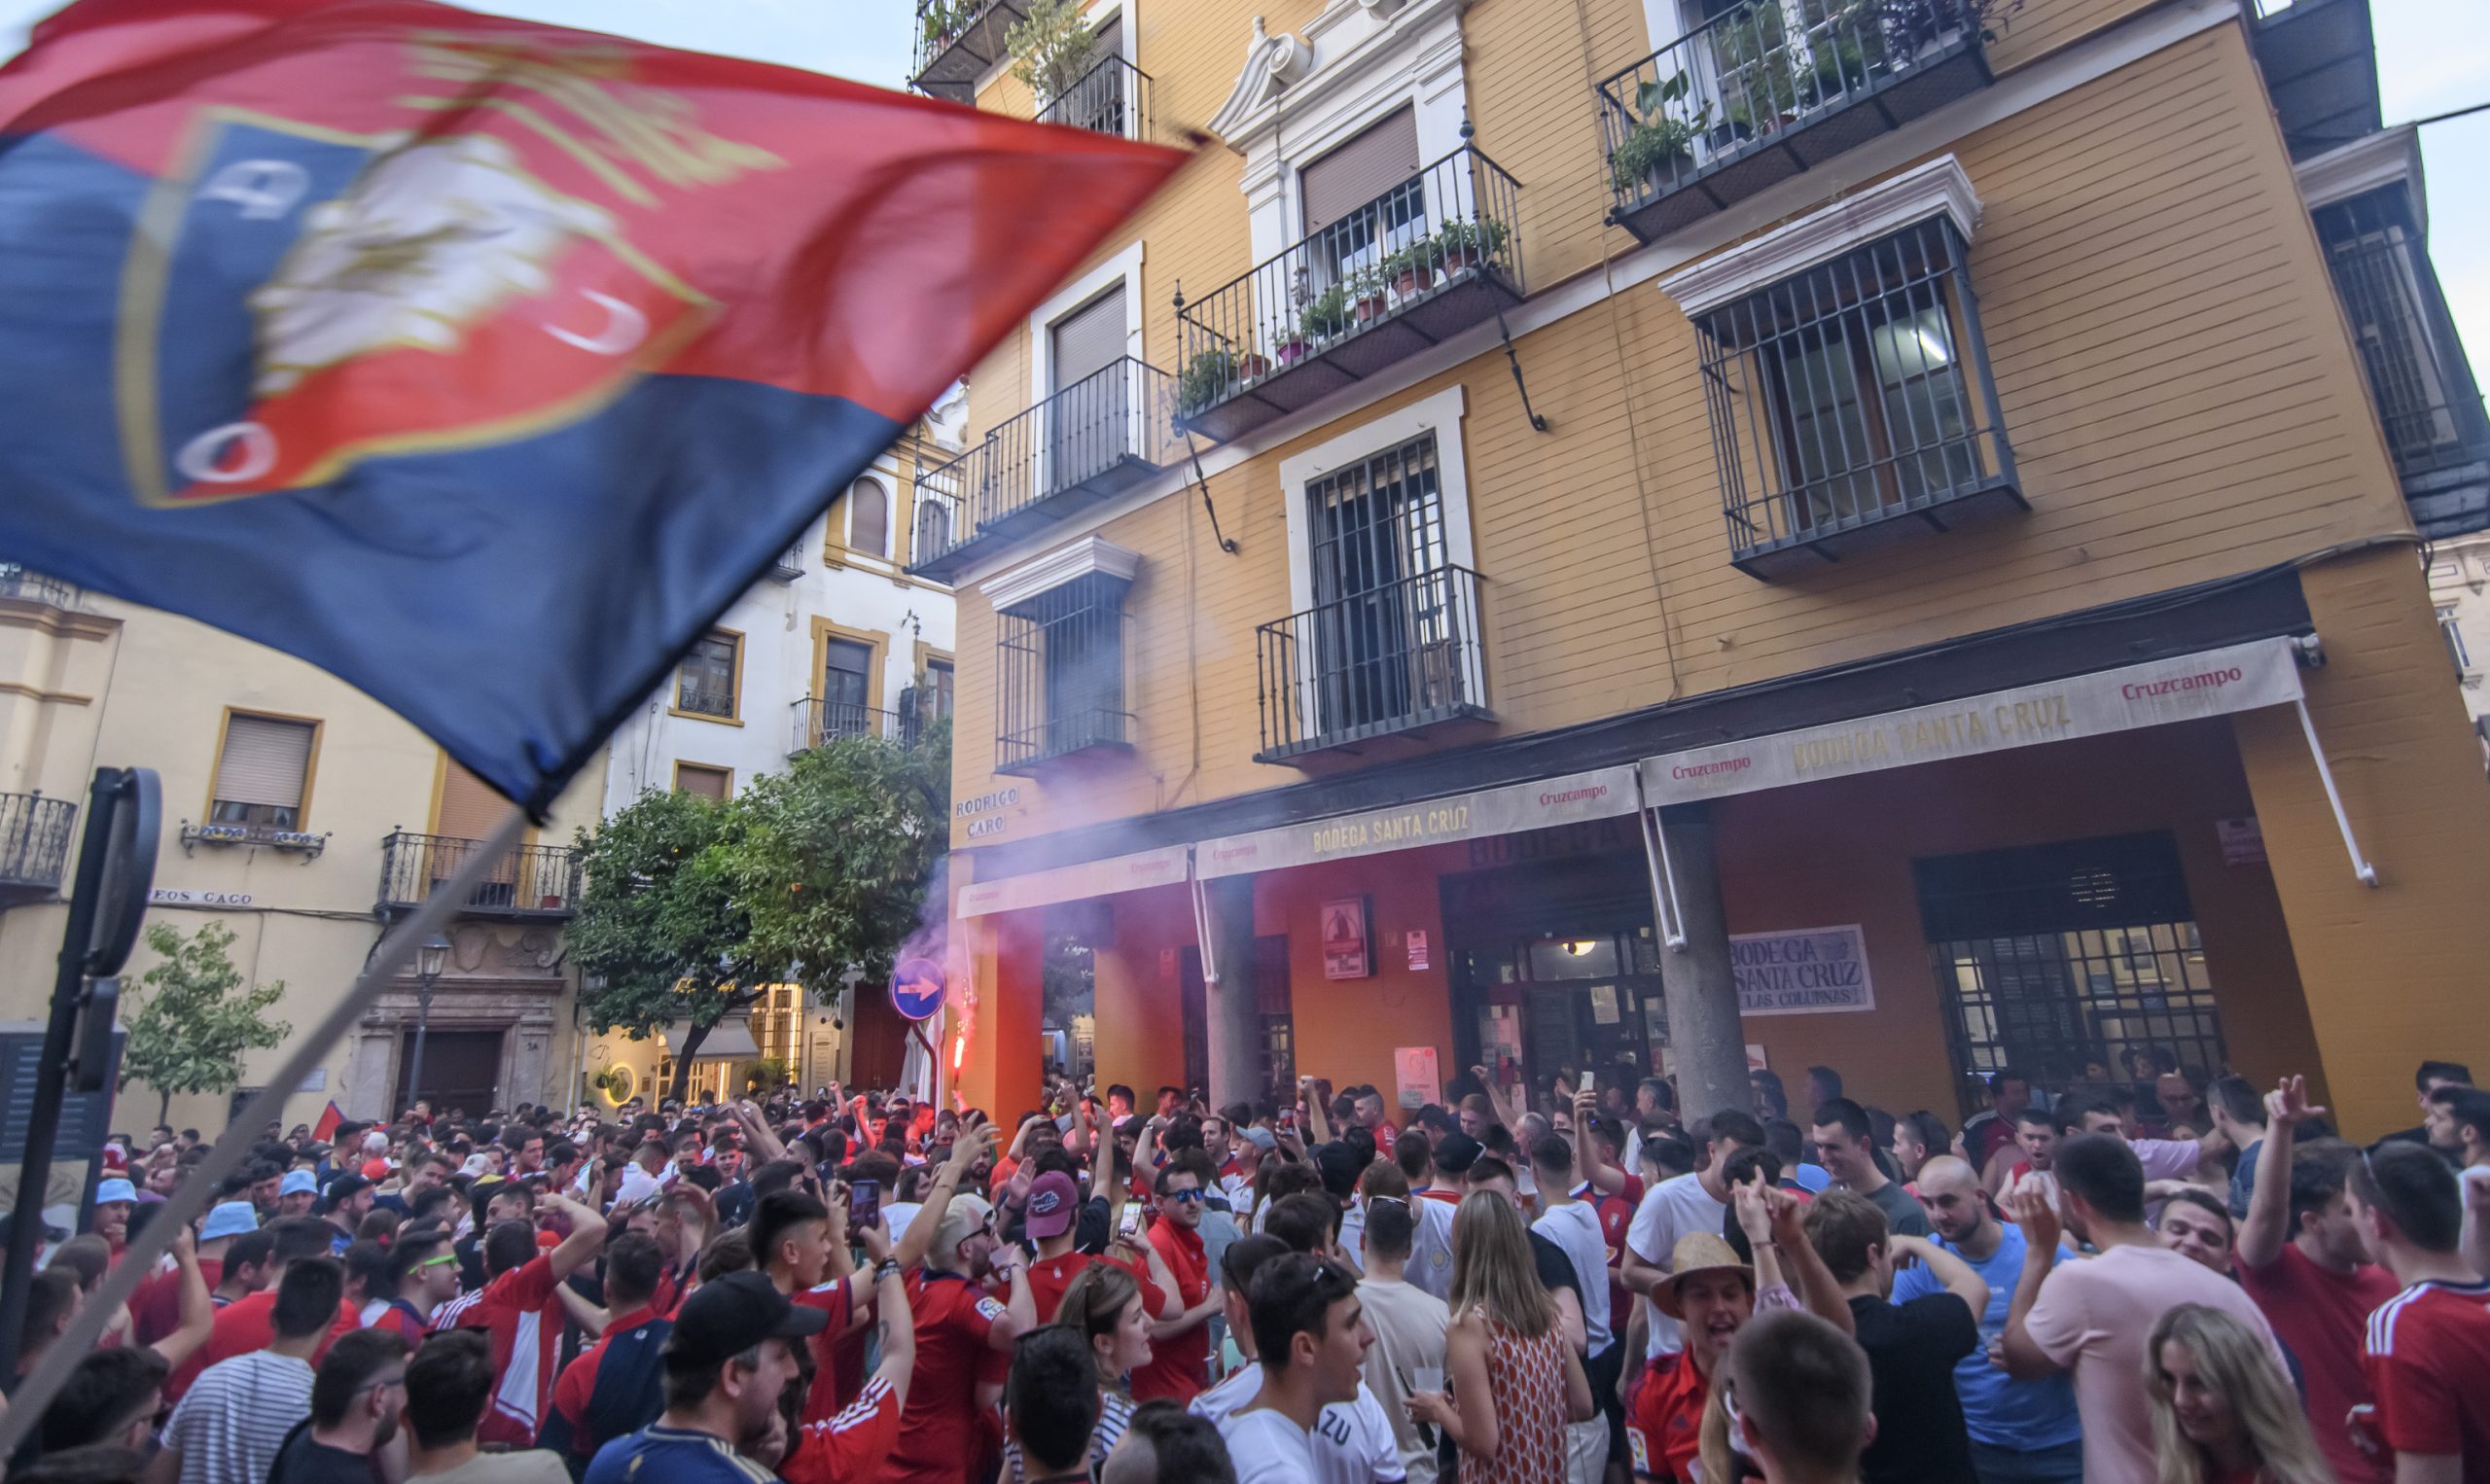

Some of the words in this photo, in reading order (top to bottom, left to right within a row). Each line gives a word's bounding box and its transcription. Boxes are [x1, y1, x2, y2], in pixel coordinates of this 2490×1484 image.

[2121, 667, 2242, 701] Cruzcampo
[1792, 727, 1888, 772] BODEGA
[1898, 711, 1986, 752] SANTA
[1996, 694, 2070, 735] CRUZ
[1672, 757, 1752, 780] Cruzcampo
[956, 789, 1016, 817] RODRIGO
[1540, 785, 1608, 806] Cruzcampo
[967, 816, 1004, 837] CARO
[1313, 824, 1368, 853] BODEGA
[1373, 813, 1422, 843] SANTA
[1428, 806, 1469, 835] CRUZ
[1730, 938, 1819, 966] BODEGA
[1735, 967, 1794, 992] SANTA
[1797, 961, 1862, 989] CRUZ
[1746, 993, 1773, 1007] LAS
